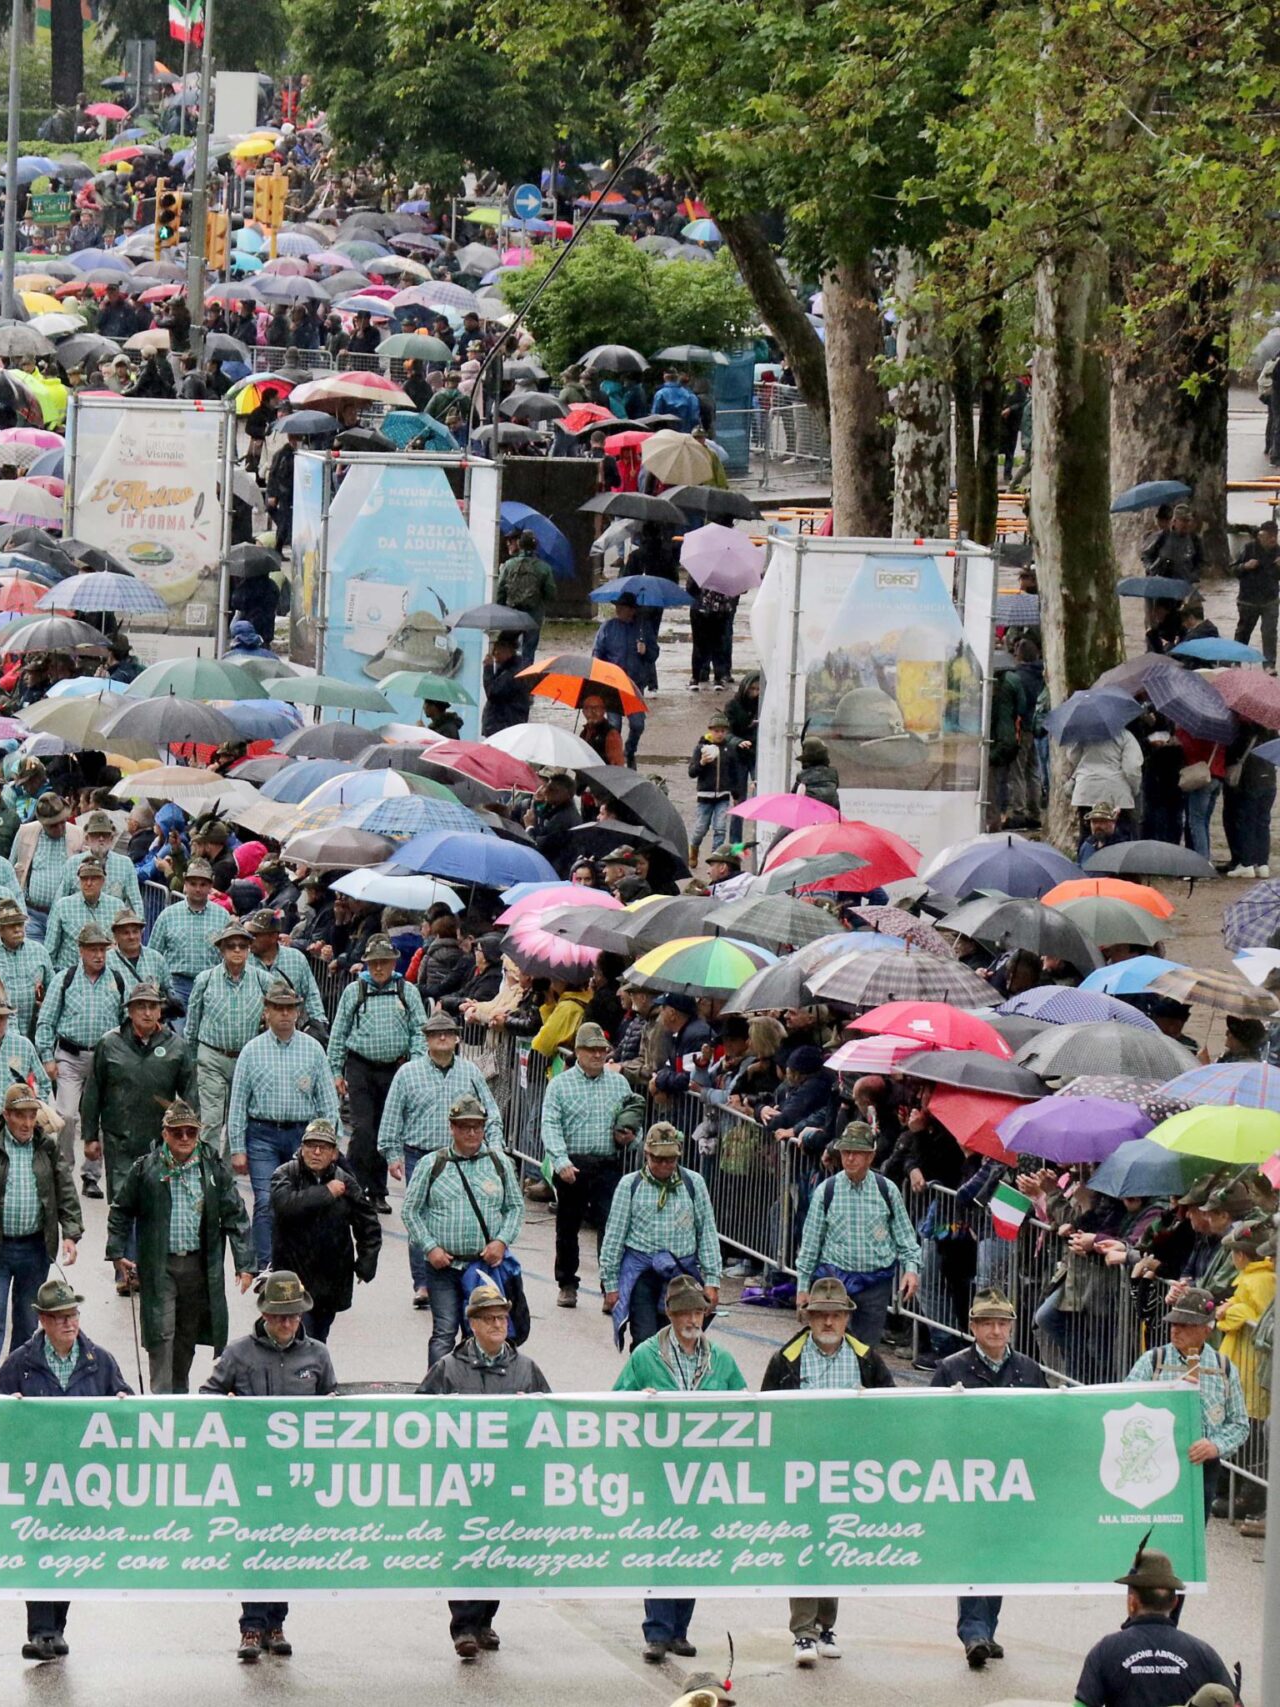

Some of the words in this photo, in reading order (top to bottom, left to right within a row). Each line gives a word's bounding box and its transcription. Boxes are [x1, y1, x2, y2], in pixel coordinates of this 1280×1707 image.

[146, 450, 185, 460] Visinale
[139, 514, 187, 531] FORMA
[377, 537, 398, 550] DA
[404, 538, 476, 552] ADUNATA
[879, 574, 917, 585] FORST
[79, 1411, 246, 1449] A.N.A.
[266, 1411, 509, 1449] SEZIONE
[525, 1411, 772, 1448] ABRUZZI
[289, 1463, 495, 1507] "JULIA"
[544, 1462, 645, 1517] Btg.
[663, 1461, 766, 1505] VAL
[785, 1458, 1036, 1504] PESCARA
[1120, 1514, 1152, 1524] SEZIONE
[1152, 1513, 1184, 1524] ABRUZZI
[710, 1518, 813, 1545] steppa
[826, 1513, 926, 1540] Russa
[38, 1551, 106, 1578] oggi
[117, 1553, 170, 1571] con
[181, 1552, 232, 1571] noi
[242, 1547, 371, 1571] duemila
[382, 1551, 444, 1571] veci
[451, 1545, 611, 1576] Abruzzesi
[621, 1546, 724, 1570] caduti
[730, 1551, 786, 1574] per
[797, 1542, 923, 1568] l'Italia
[1121, 1649, 1154, 1669] SEZIONE
[1154, 1649, 1189, 1669] ABRUZZI
